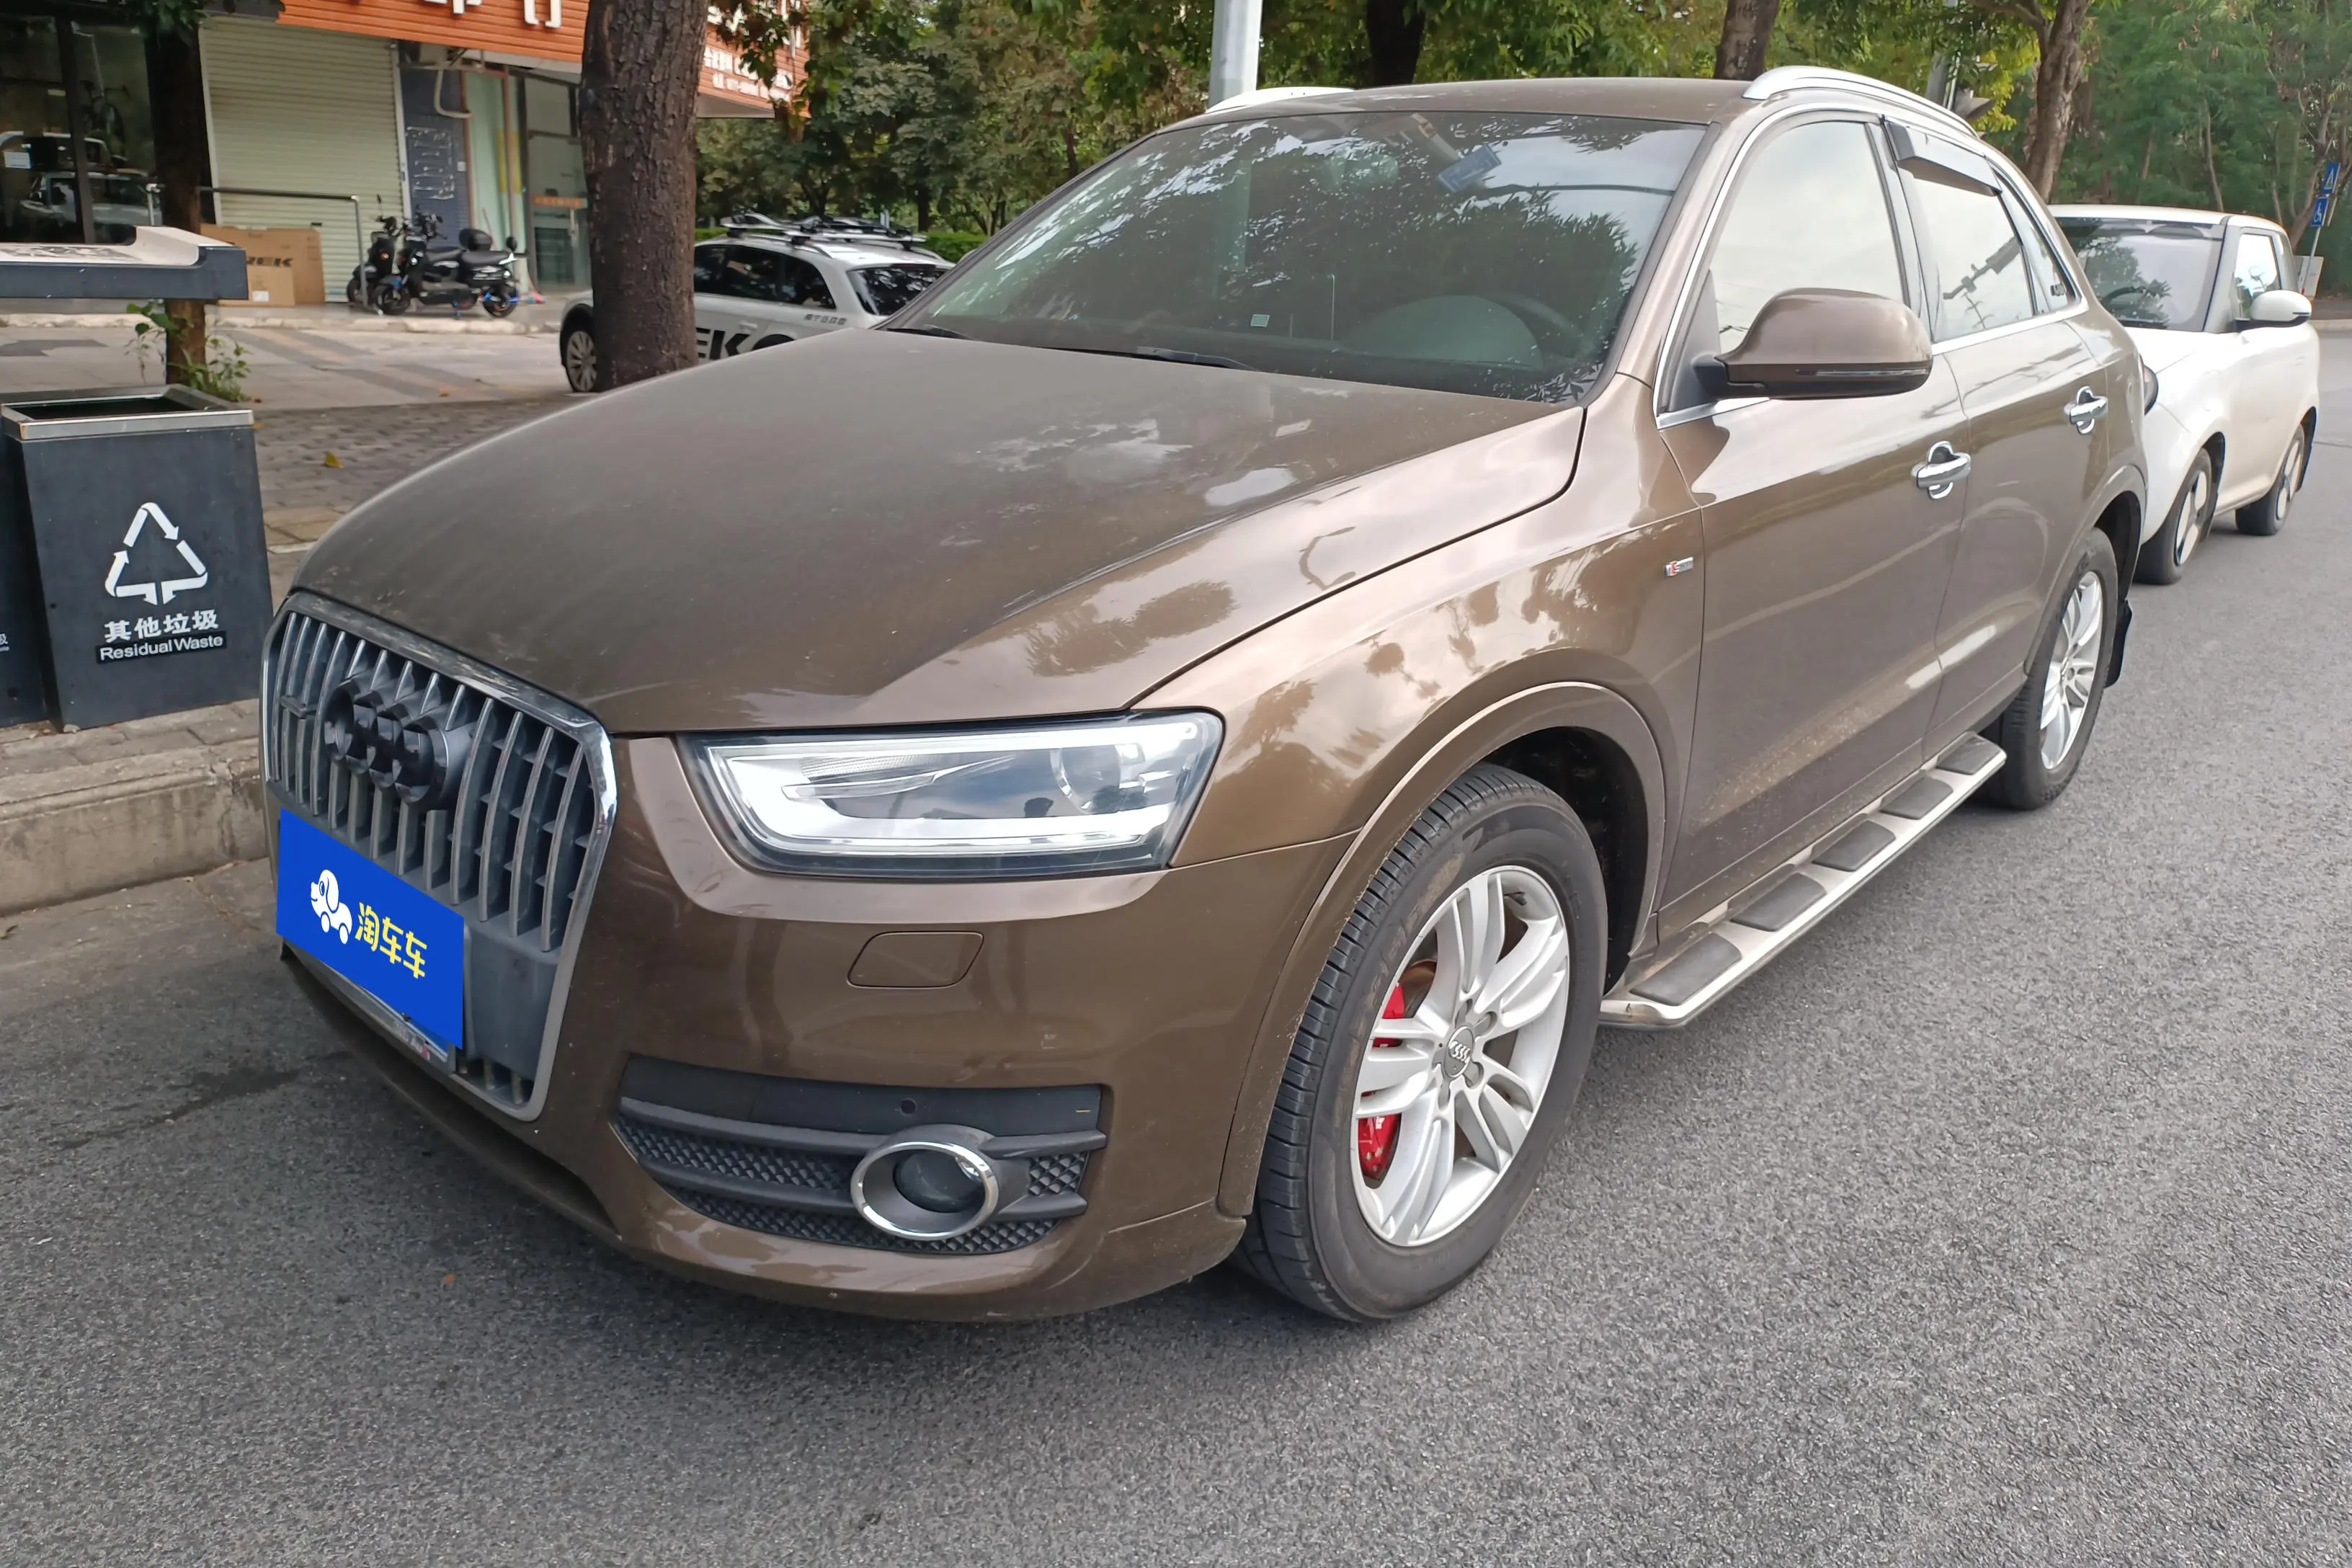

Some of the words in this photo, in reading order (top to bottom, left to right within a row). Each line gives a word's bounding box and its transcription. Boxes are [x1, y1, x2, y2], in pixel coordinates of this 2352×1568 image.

[104, 609, 219, 643] 其他垃圾
[101, 639, 172, 661] Residual
[174, 636, 223, 651] Waste
